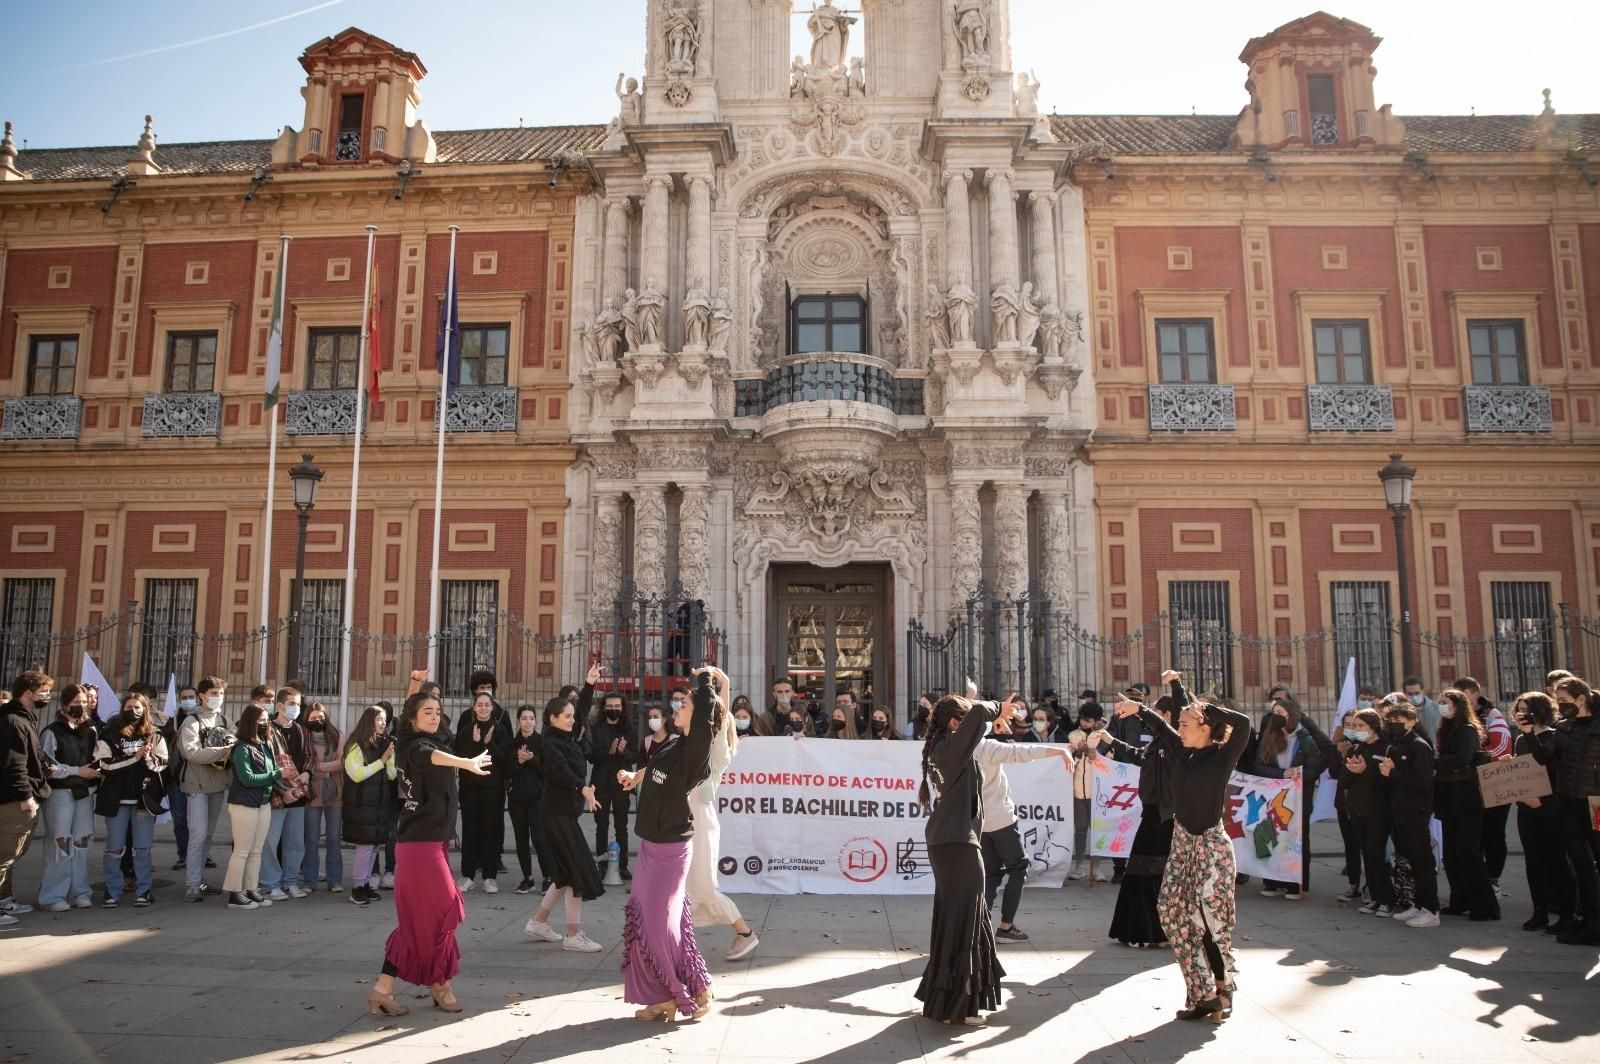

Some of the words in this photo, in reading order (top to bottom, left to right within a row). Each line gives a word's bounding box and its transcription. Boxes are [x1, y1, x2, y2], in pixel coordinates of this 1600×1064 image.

[720, 773, 736, 785] ES
[740, 773, 825, 787] MOMENTO
[828, 775, 848, 788] DE
[851, 777, 915, 791] ACTUAR
[718, 797, 756, 814] POR
[760, 797, 778, 814] EL
[782, 797, 880, 818] BACHILLER
[883, 801, 905, 818] DE
